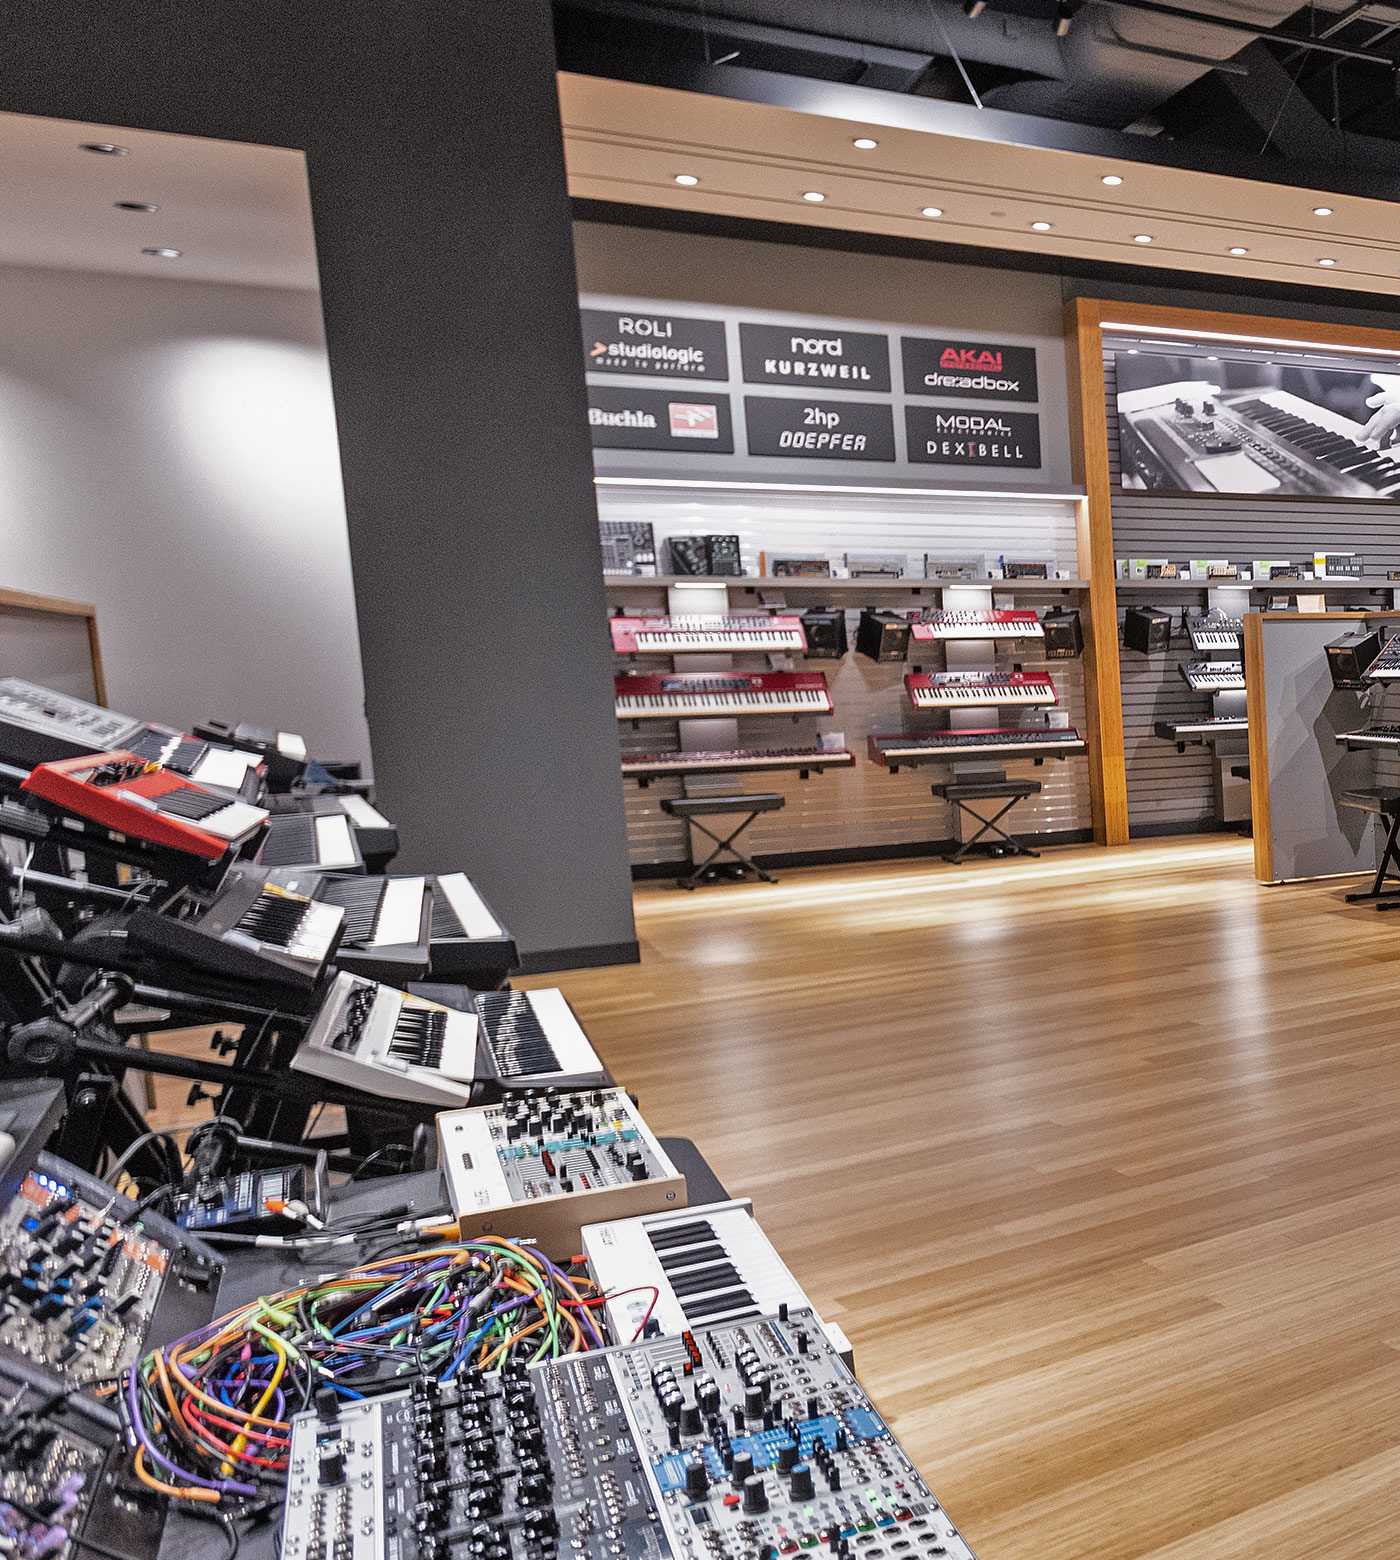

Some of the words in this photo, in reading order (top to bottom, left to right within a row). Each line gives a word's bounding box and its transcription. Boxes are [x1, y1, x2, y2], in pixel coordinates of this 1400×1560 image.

[618, 317, 672, 338] ROLI
[607, 341, 704, 364] studiologic
[791, 337, 842, 356] nord
[939, 347, 1003, 365] AKAI
[764, 359, 871, 380] KURZWEIL
[924, 371, 1020, 392] dreadbox
[588, 407, 657, 428] Buchla
[803, 407, 840, 429] 2hp
[936, 414, 1011, 432] MODAL
[779, 430, 867, 451] DOEPFER
